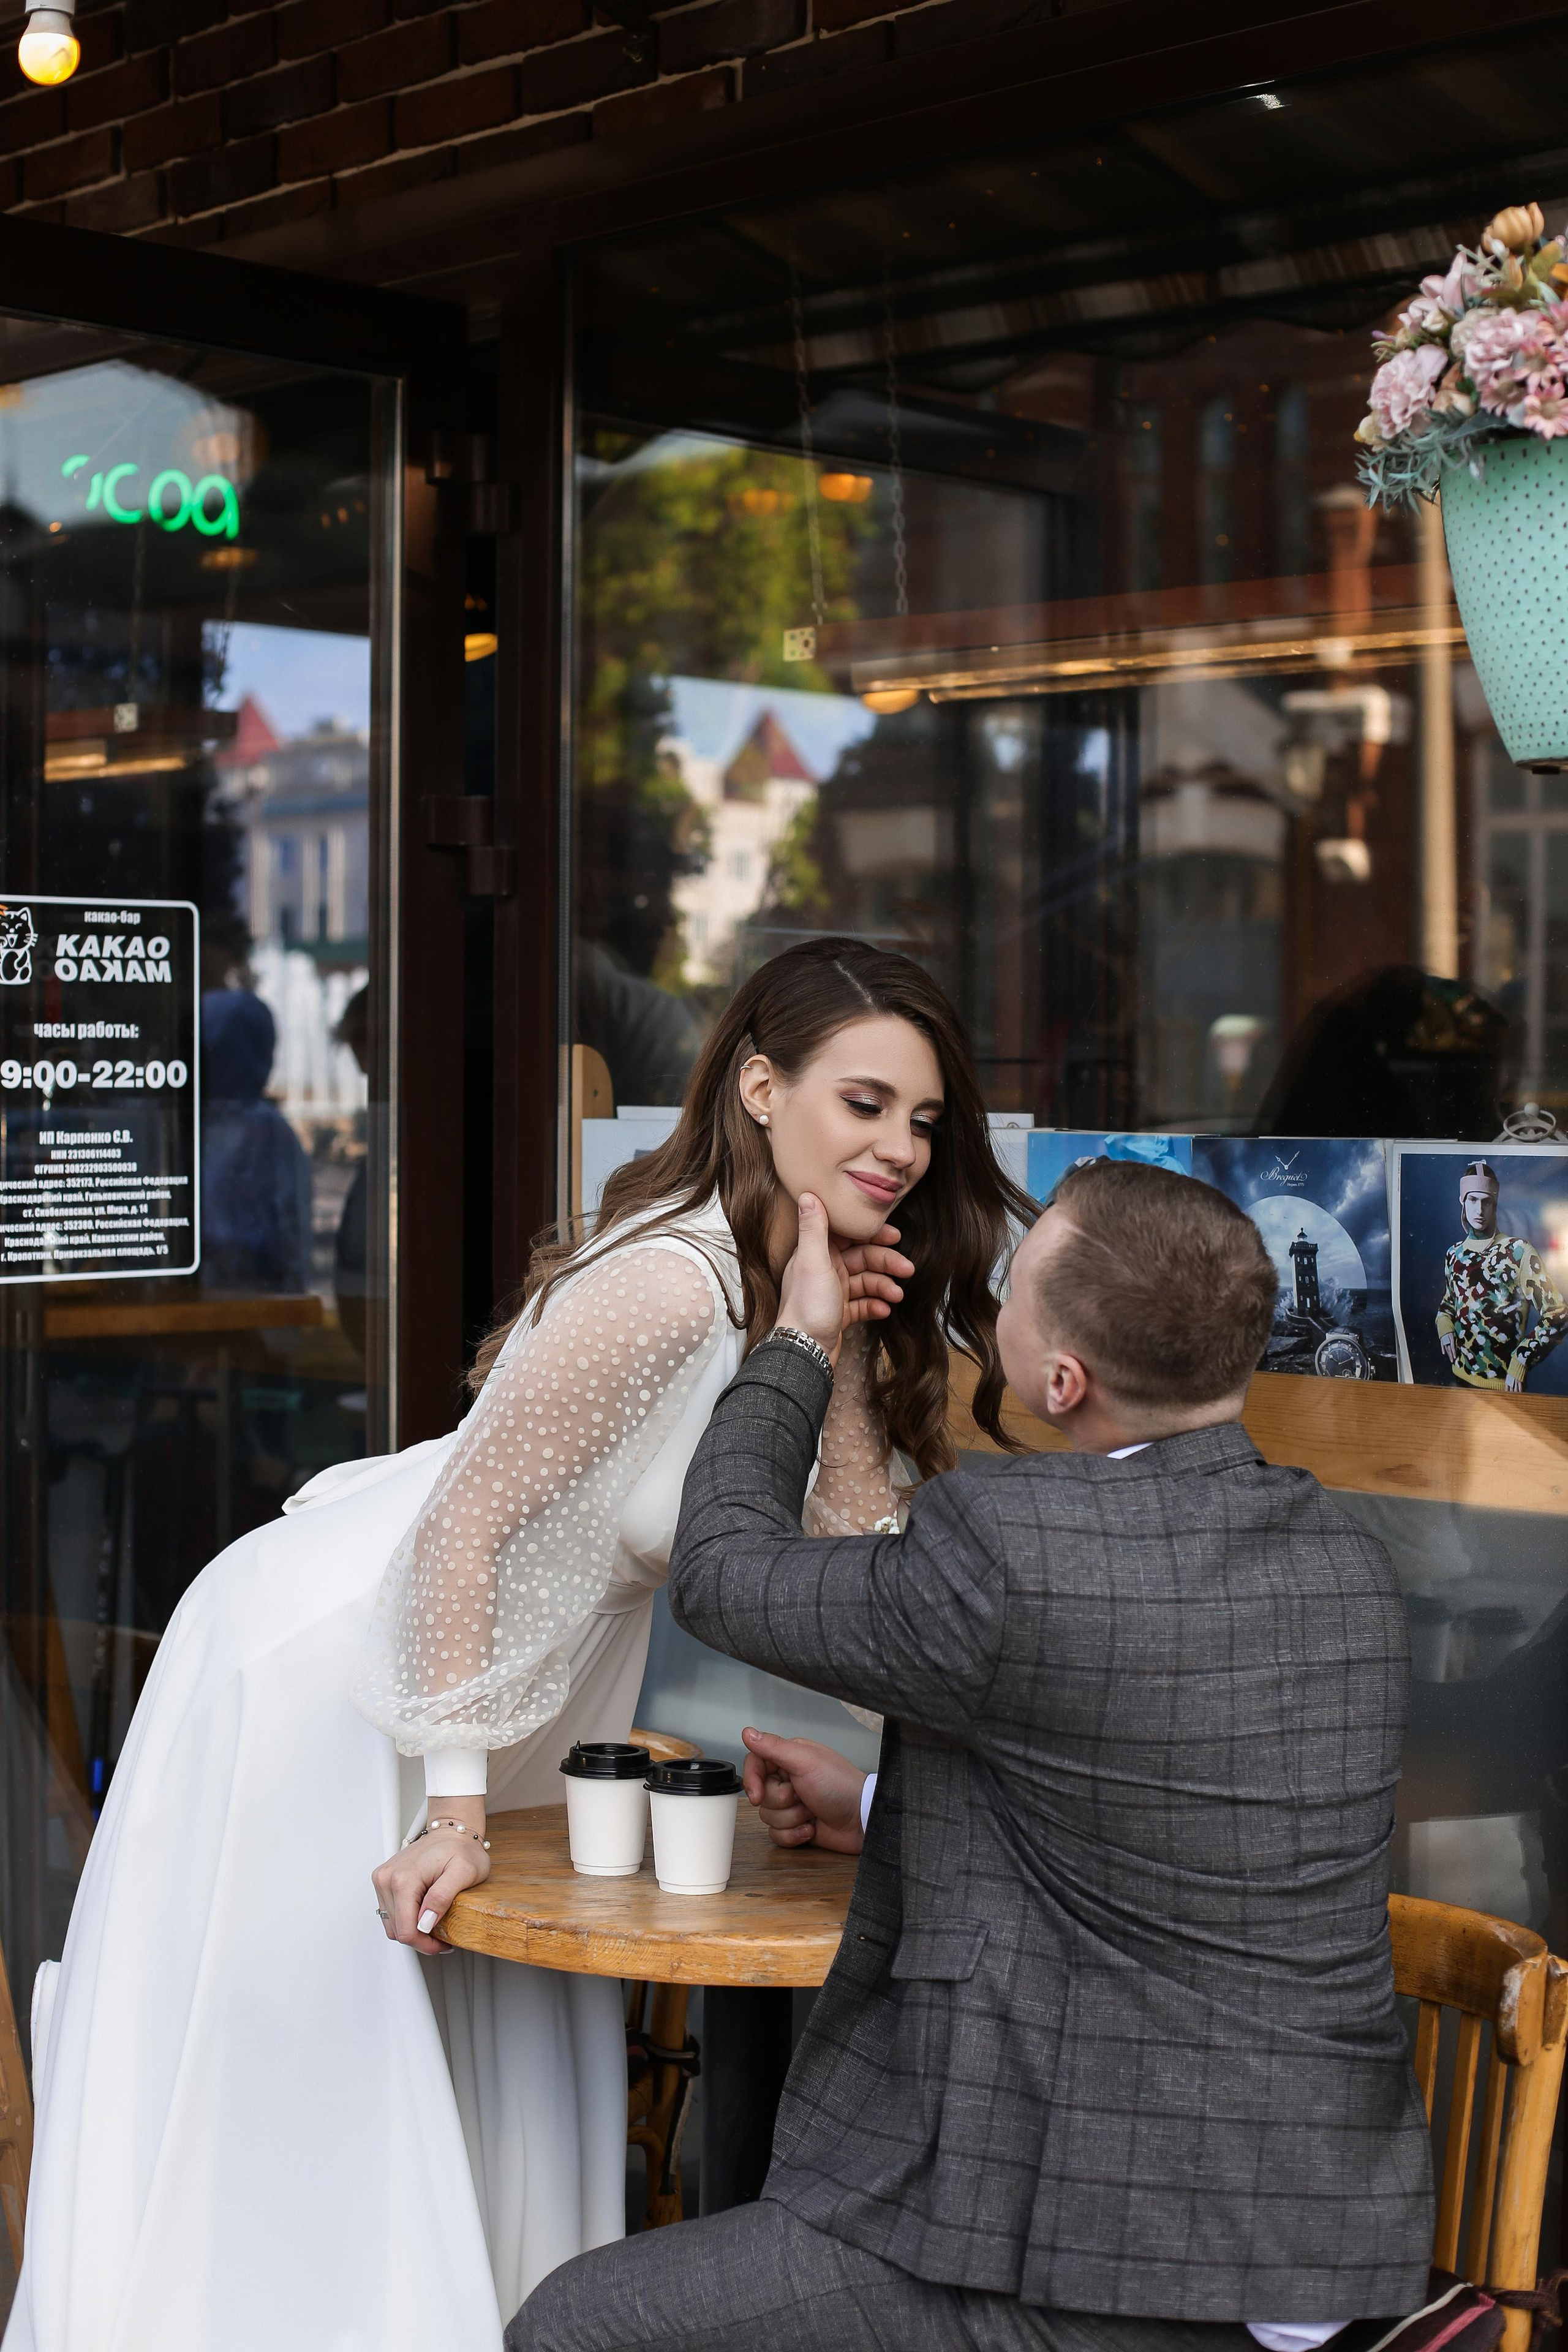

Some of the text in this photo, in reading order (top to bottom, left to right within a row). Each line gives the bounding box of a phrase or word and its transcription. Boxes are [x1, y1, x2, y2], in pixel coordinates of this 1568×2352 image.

[84, 910, 141, 924] какао-бар
[56, 934, 171, 959] КАКАО
[34, 1020, 139, 1040] часы работы:
[1, 1060, 187, 1089] 9:00-22:00
[39, 1131, 55, 1145] ИП
[56, 1131, 111, 1145] Карпенко
[1261, 1166, 1308, 1186] Breguet
